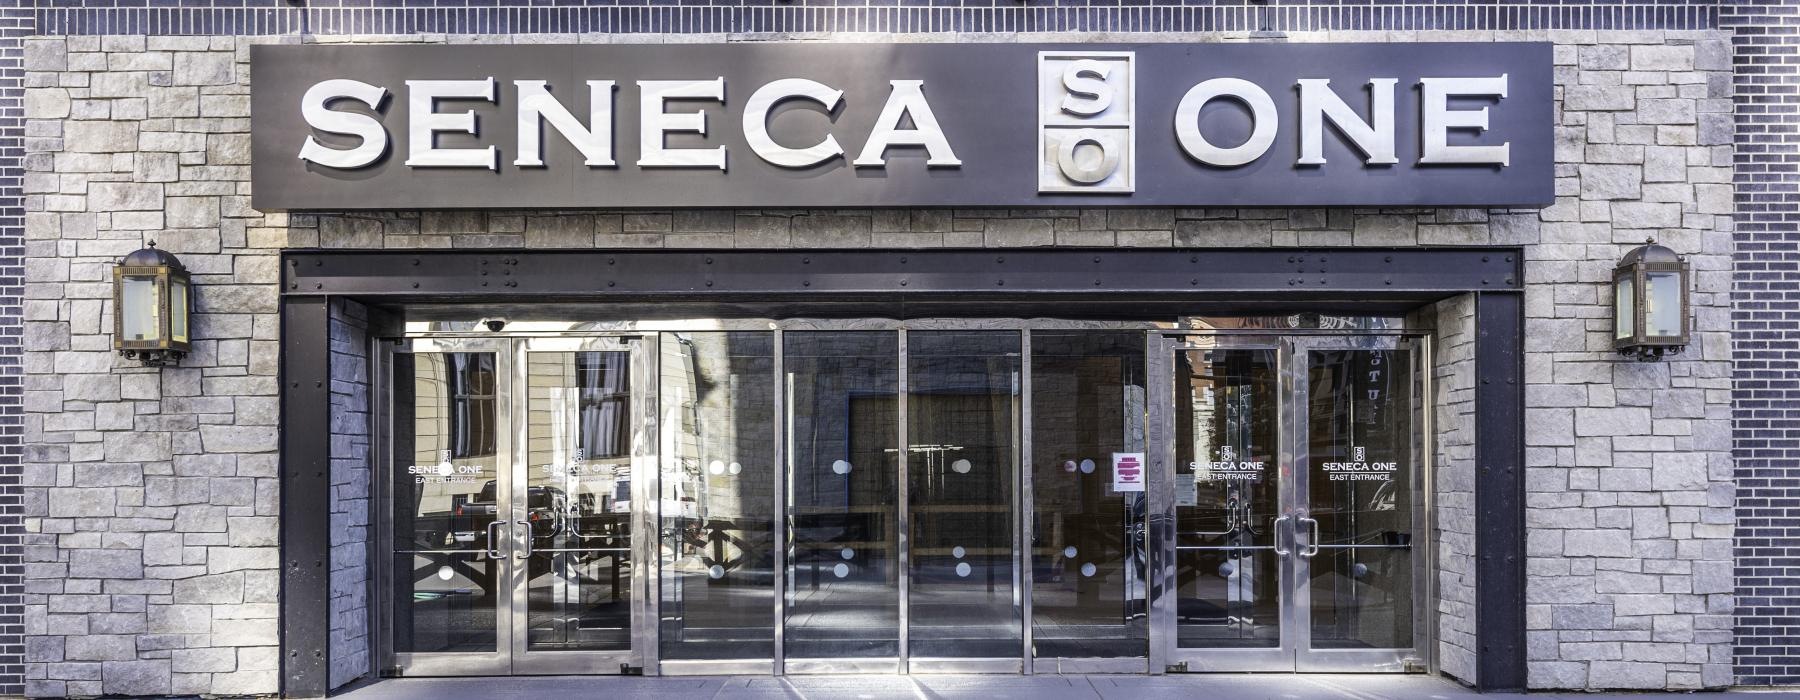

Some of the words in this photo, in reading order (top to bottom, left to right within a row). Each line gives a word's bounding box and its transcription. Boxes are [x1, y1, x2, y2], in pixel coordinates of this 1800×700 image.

[1061, 59, 1112, 116] S
[298, 76, 962, 171] SENECA
[1174, 73, 1510, 168] ONE
[1058, 127, 1119, 184] O
[458, 465, 483, 474] ONE
[1189, 461, 1237, 470] SENECA
[1239, 461, 1265, 470] ONE
[1322, 462, 1370, 471] SENECA
[1371, 462, 1398, 471] ONE
[1329, 473, 1348, 481] EAST
[1350, 473, 1390, 481] ENTRANCE
